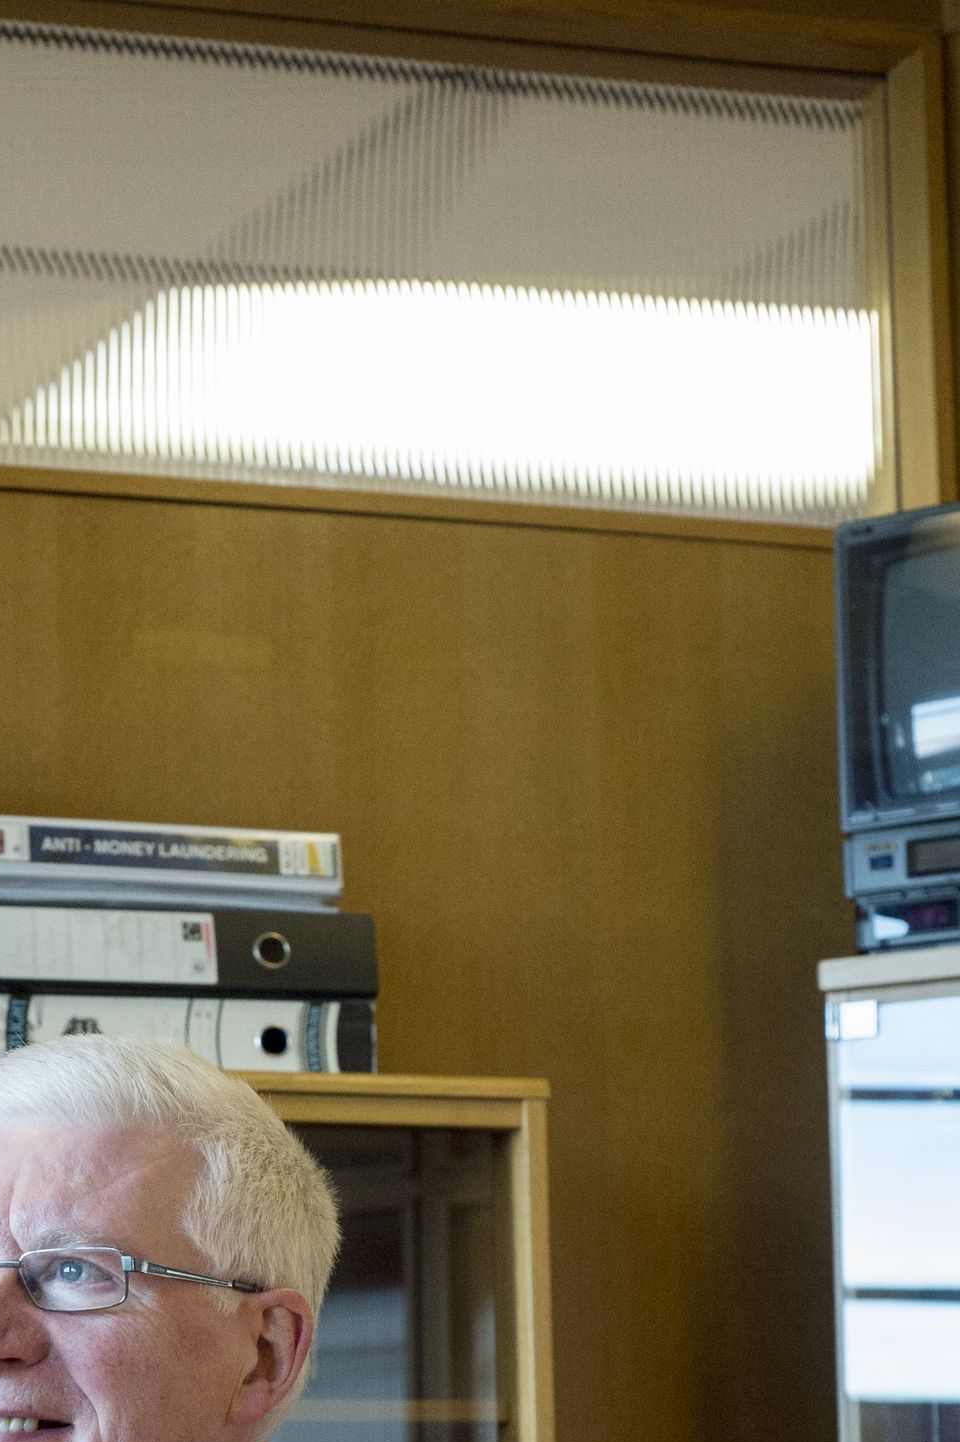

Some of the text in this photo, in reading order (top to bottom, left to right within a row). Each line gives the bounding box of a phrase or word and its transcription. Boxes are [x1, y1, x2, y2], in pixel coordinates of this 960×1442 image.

[41, 835, 82, 854] ANTI
[93, 838, 157, 858] MONEY
[157, 841, 269, 864] LAUNDERING
